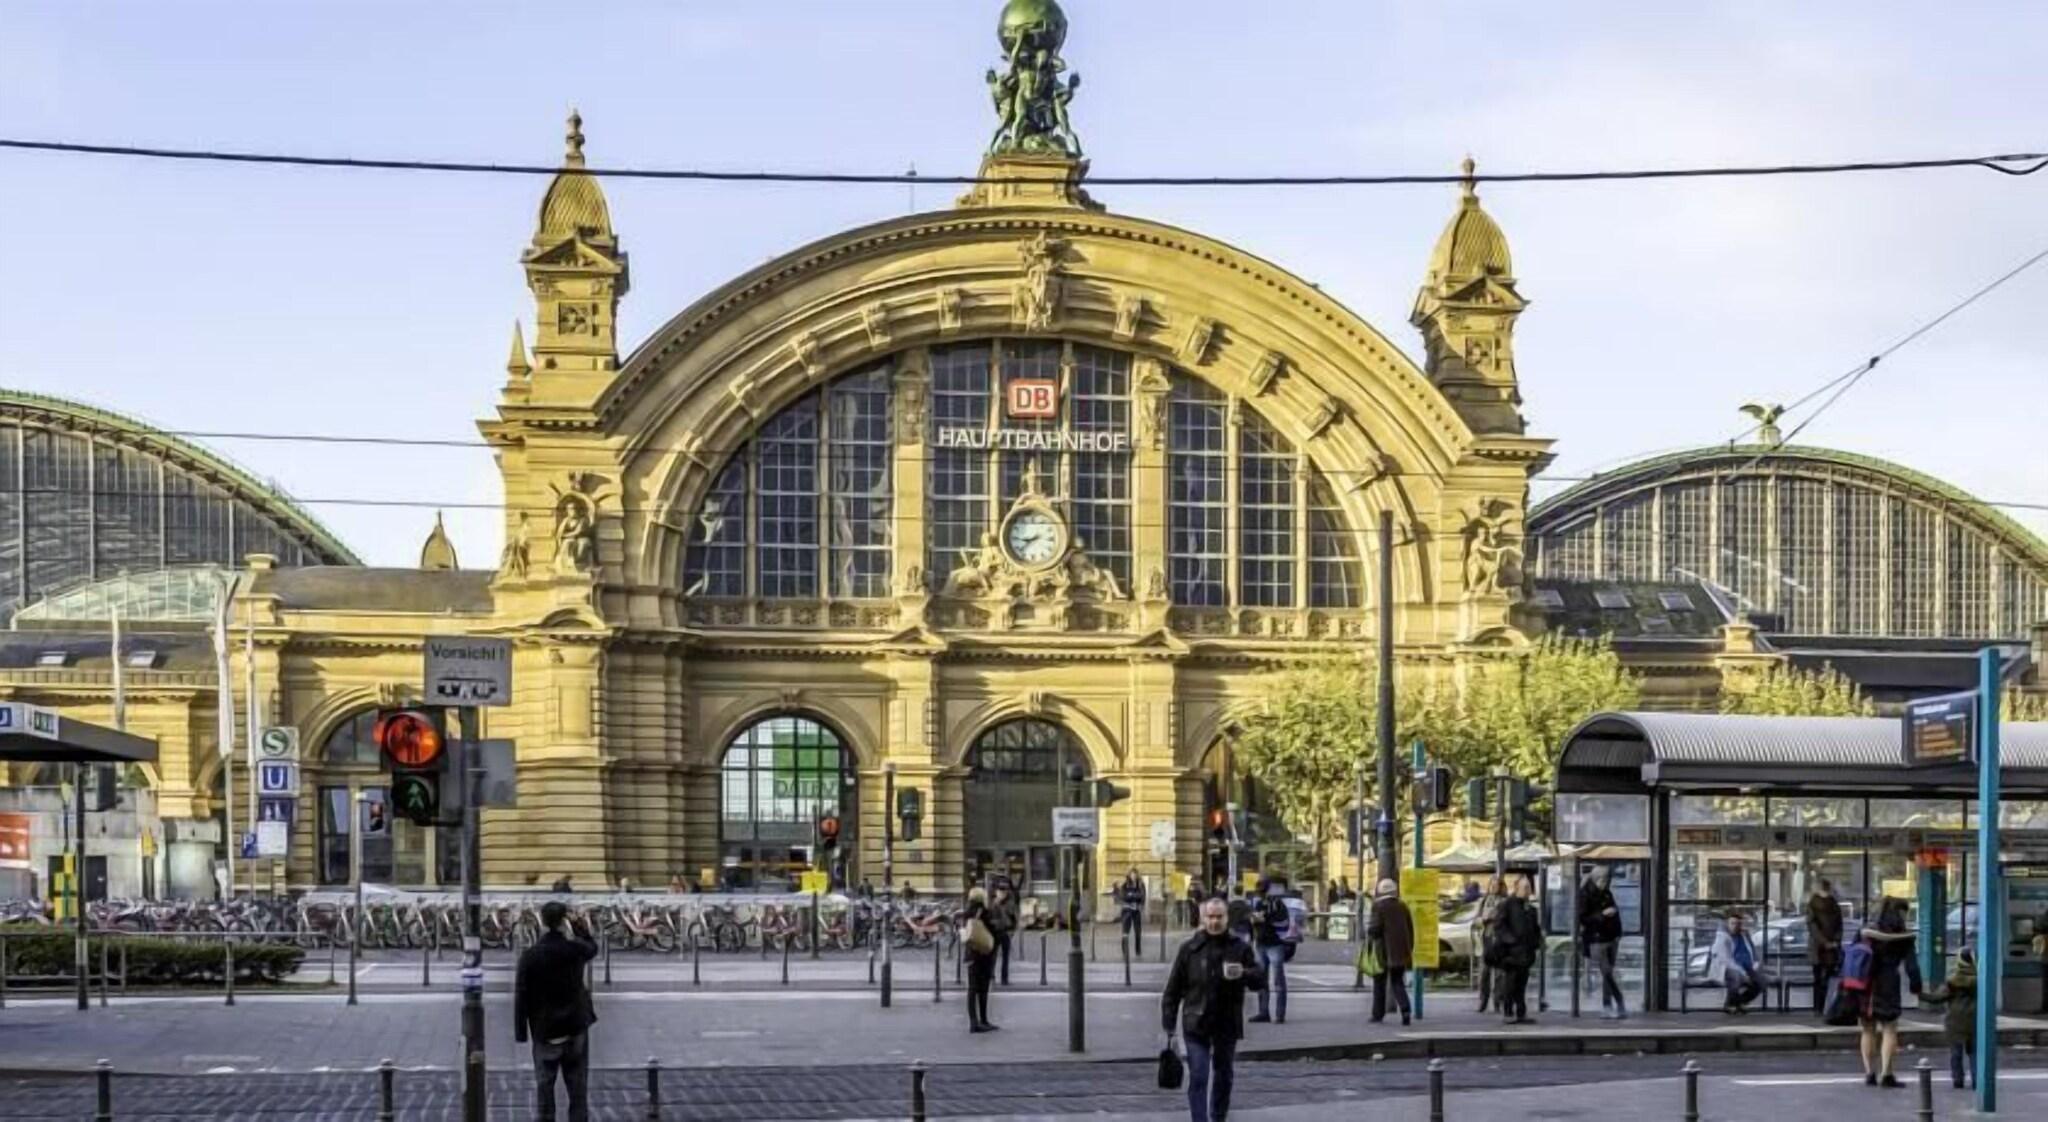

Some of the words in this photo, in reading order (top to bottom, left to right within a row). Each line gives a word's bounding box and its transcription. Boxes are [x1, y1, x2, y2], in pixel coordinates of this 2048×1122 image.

[1016, 387, 1050, 411] DB
[938, 426, 1128, 452] HAUPTBAHNHOF
[264, 730, 286, 755] S
[267, 766, 285, 789] U
